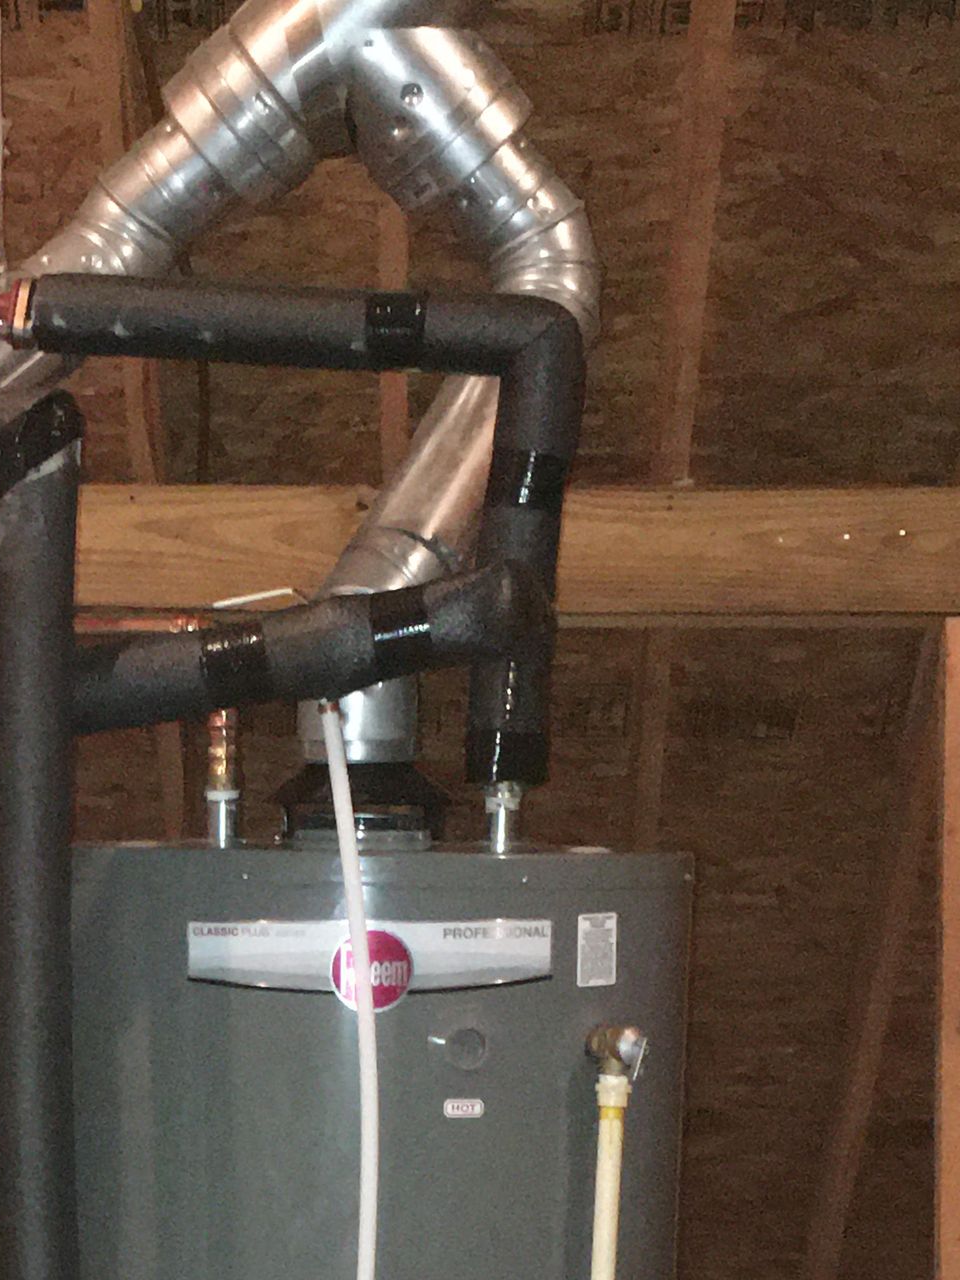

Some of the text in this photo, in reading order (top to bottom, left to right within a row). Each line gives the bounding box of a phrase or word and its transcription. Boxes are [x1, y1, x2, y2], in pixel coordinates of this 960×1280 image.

[193, 926, 239, 937] CLASSIC
[340, 936, 410, 999] Reem
[450, 1102, 476, 1113] HOT
